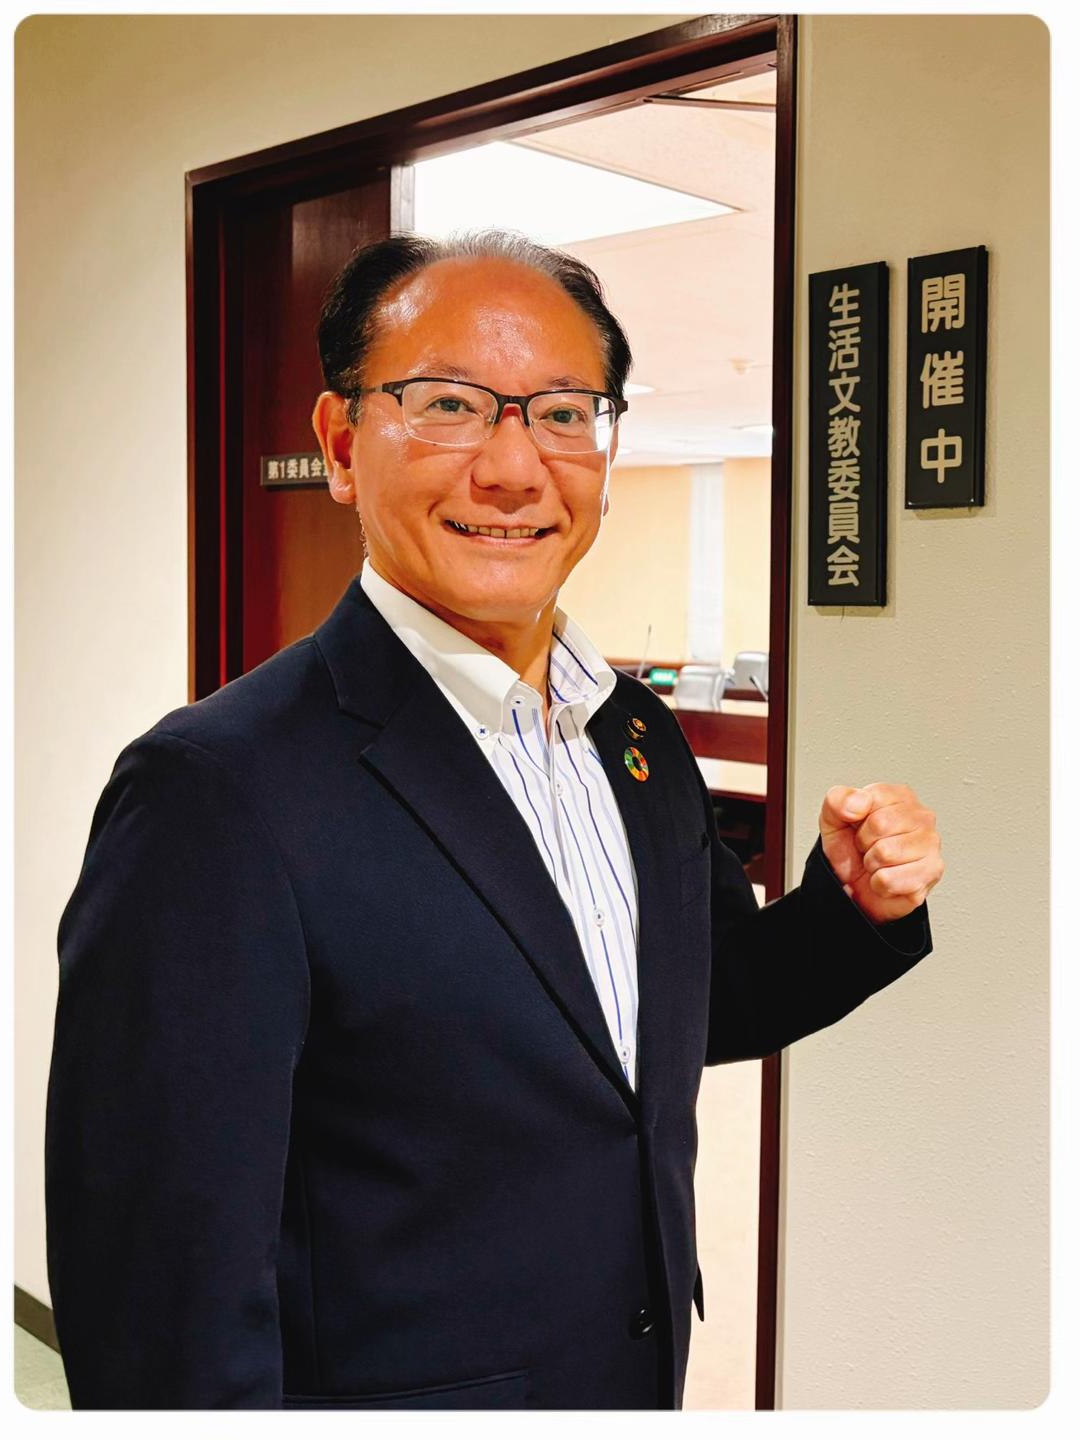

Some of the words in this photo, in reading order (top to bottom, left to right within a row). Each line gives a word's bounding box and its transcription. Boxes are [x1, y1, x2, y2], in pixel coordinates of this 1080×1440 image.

[827, 283, 862, 588] 生活文教委員会
[920, 272, 967, 483] 開催中
